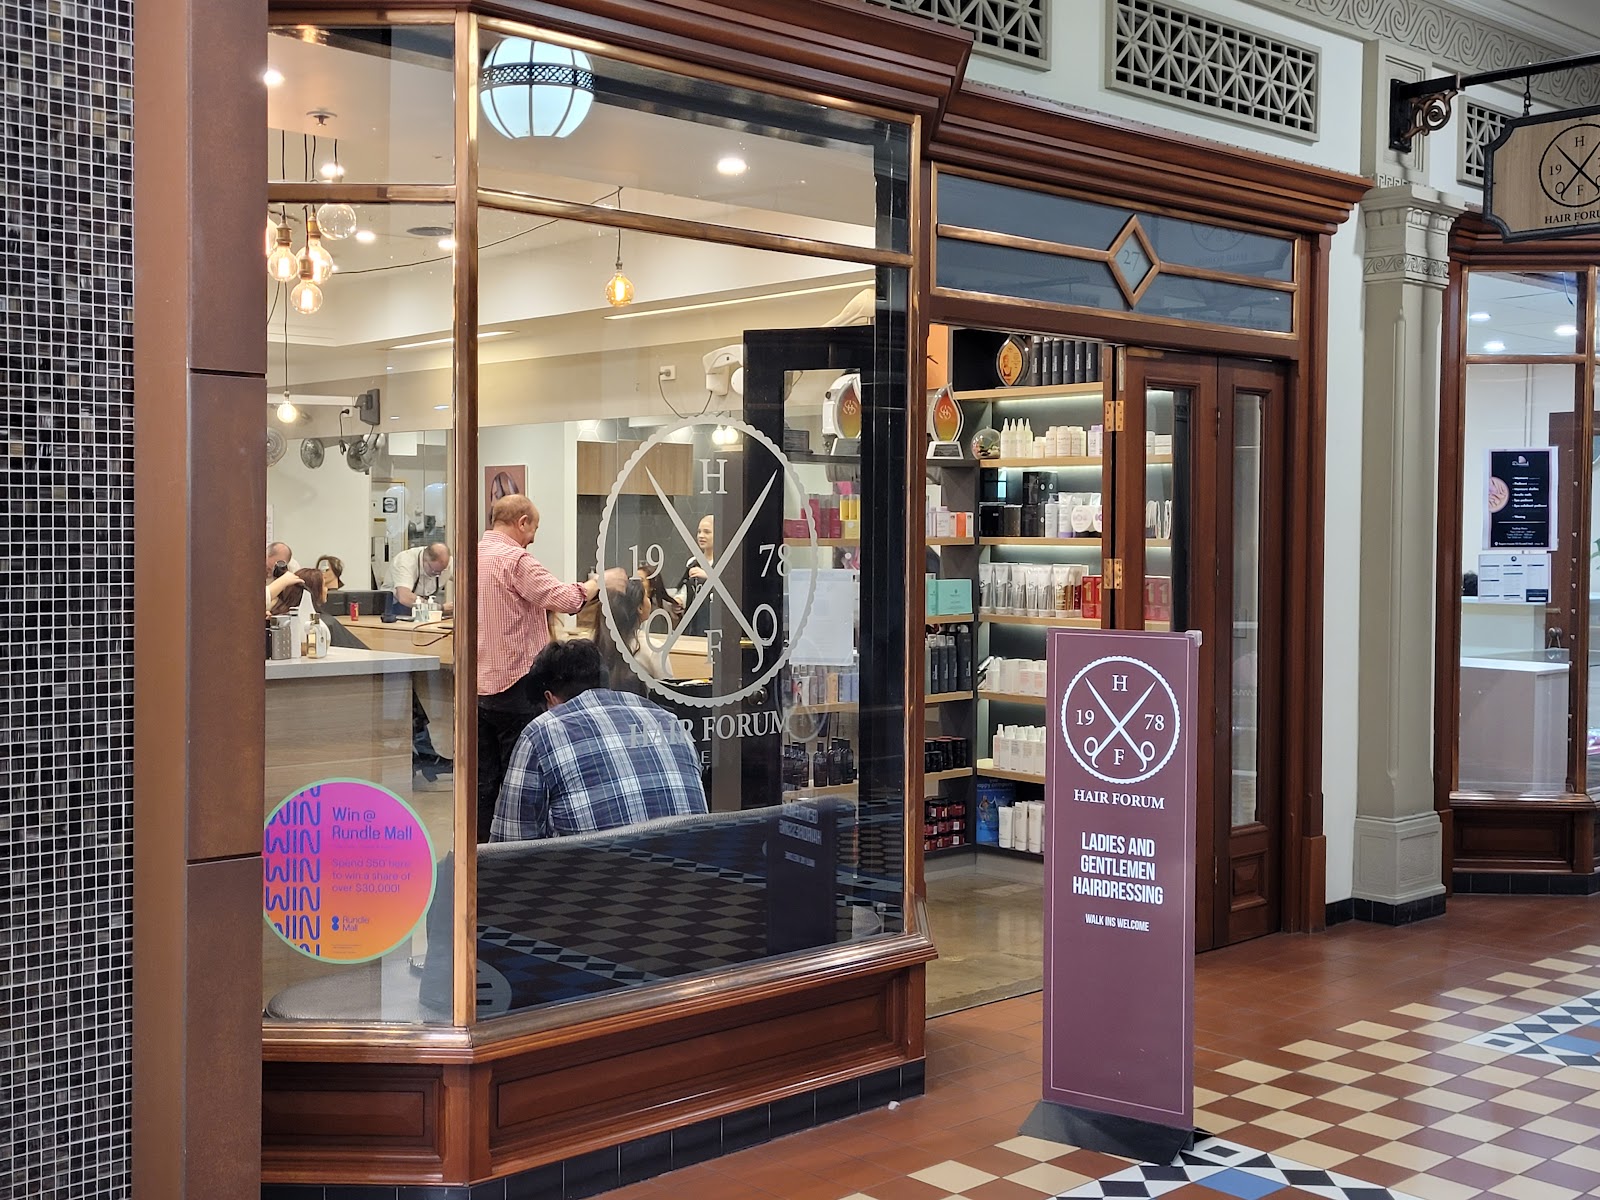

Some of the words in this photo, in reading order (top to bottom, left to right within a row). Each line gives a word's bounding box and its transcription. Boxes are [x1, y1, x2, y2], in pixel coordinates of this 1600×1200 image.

[1574, 135, 1585, 147] H
[1549, 164, 1562, 176] 19
[1577, 184, 1584, 196] F
[1544, 211, 1571, 224] HAIR
[1573, 209, 1600, 221] FOR
[1123, 249, 1140, 271] 27
[699, 458, 728, 495] H
[628, 543, 665, 581] 19
[758, 543, 793, 579] 78
[703, 628, 724, 665] F
[1112, 674, 1128, 692] H
[629, 715, 697, 750] HAIR
[702, 710, 791, 742] FORUM
[1075, 709, 1095, 726] 19
[1144, 714, 1165, 732] 78
[1113, 748, 1125, 766] F
[1073, 789, 1110, 805] HAIR
[1112, 793, 1165, 810] FORUM
[332, 807, 360, 822] Win
[363, 809, 376, 823] @
[265, 829, 321, 855] WIN
[332, 825, 381, 841] Rundle
[384, 826, 413, 841] Mall
[1081, 832, 1126, 855] LADIES
[1128, 837, 1156, 858] AND
[265, 857, 321, 883] WIN
[332, 858, 363, 869] Spend
[1080, 854, 1156, 881] GENTLEMEN
[332, 871, 342, 880] to
[344, 871, 361, 880] win
[372, 871, 398, 880] share
[400, 872, 412, 881] of
[332, 885, 352, 893] over
[355, 883, 400, 894] $30,000!
[1072, 876, 1164, 905] HAIRDRESSING
[265, 886, 321, 912] WIN
[342, 915, 369, 924] Rundle
[342, 924, 358, 932] Mall
[1085, 913, 1104, 926] WALK
[1105, 916, 1116, 928] INS
[1117, 917, 1150, 932] WELCOME
